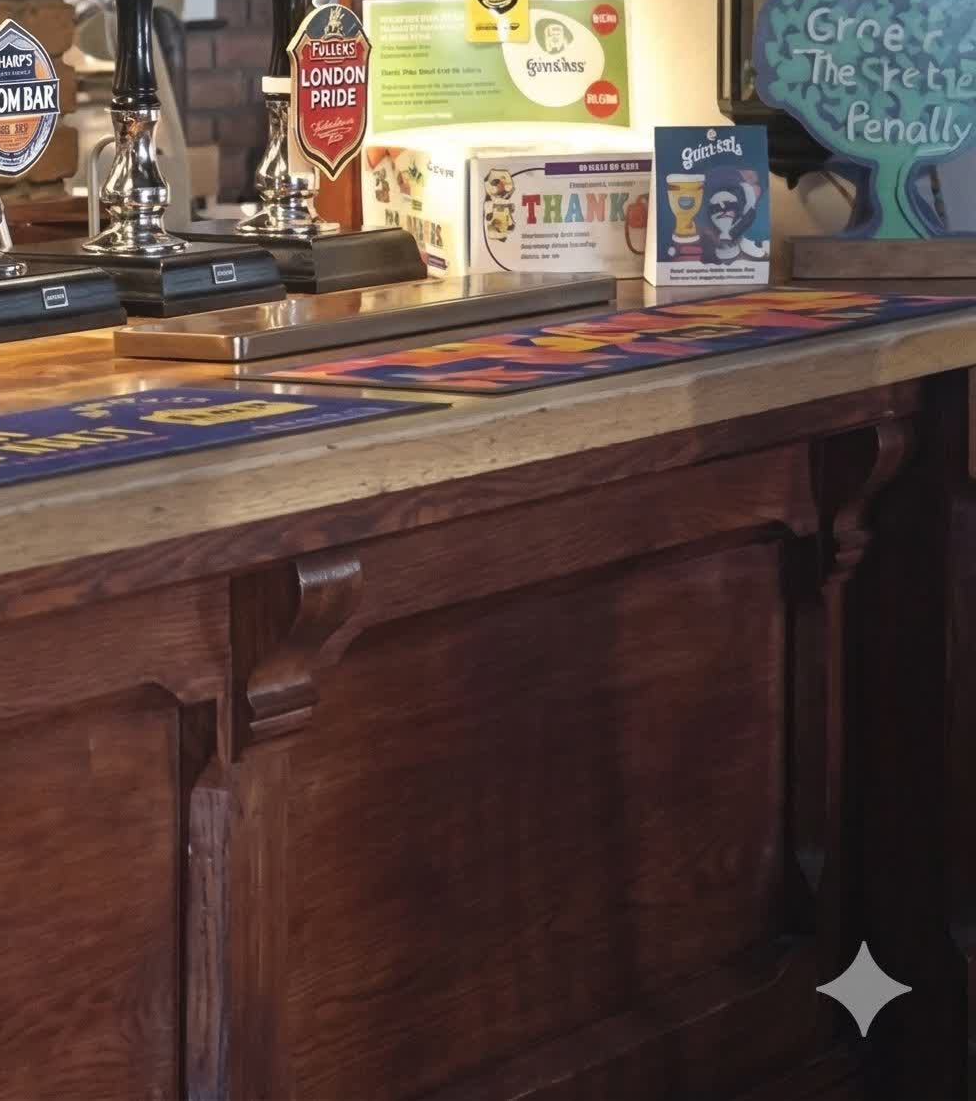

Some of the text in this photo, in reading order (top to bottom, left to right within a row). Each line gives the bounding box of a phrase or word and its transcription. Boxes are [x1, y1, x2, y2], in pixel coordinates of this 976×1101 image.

[301, 65, 366, 87] LONDON
[792, 49, 857, 87] The
[24, 85, 56, 111] BAR
[311, 88, 357, 109] PRIDE
[847, 100, 972, 156] Penally
